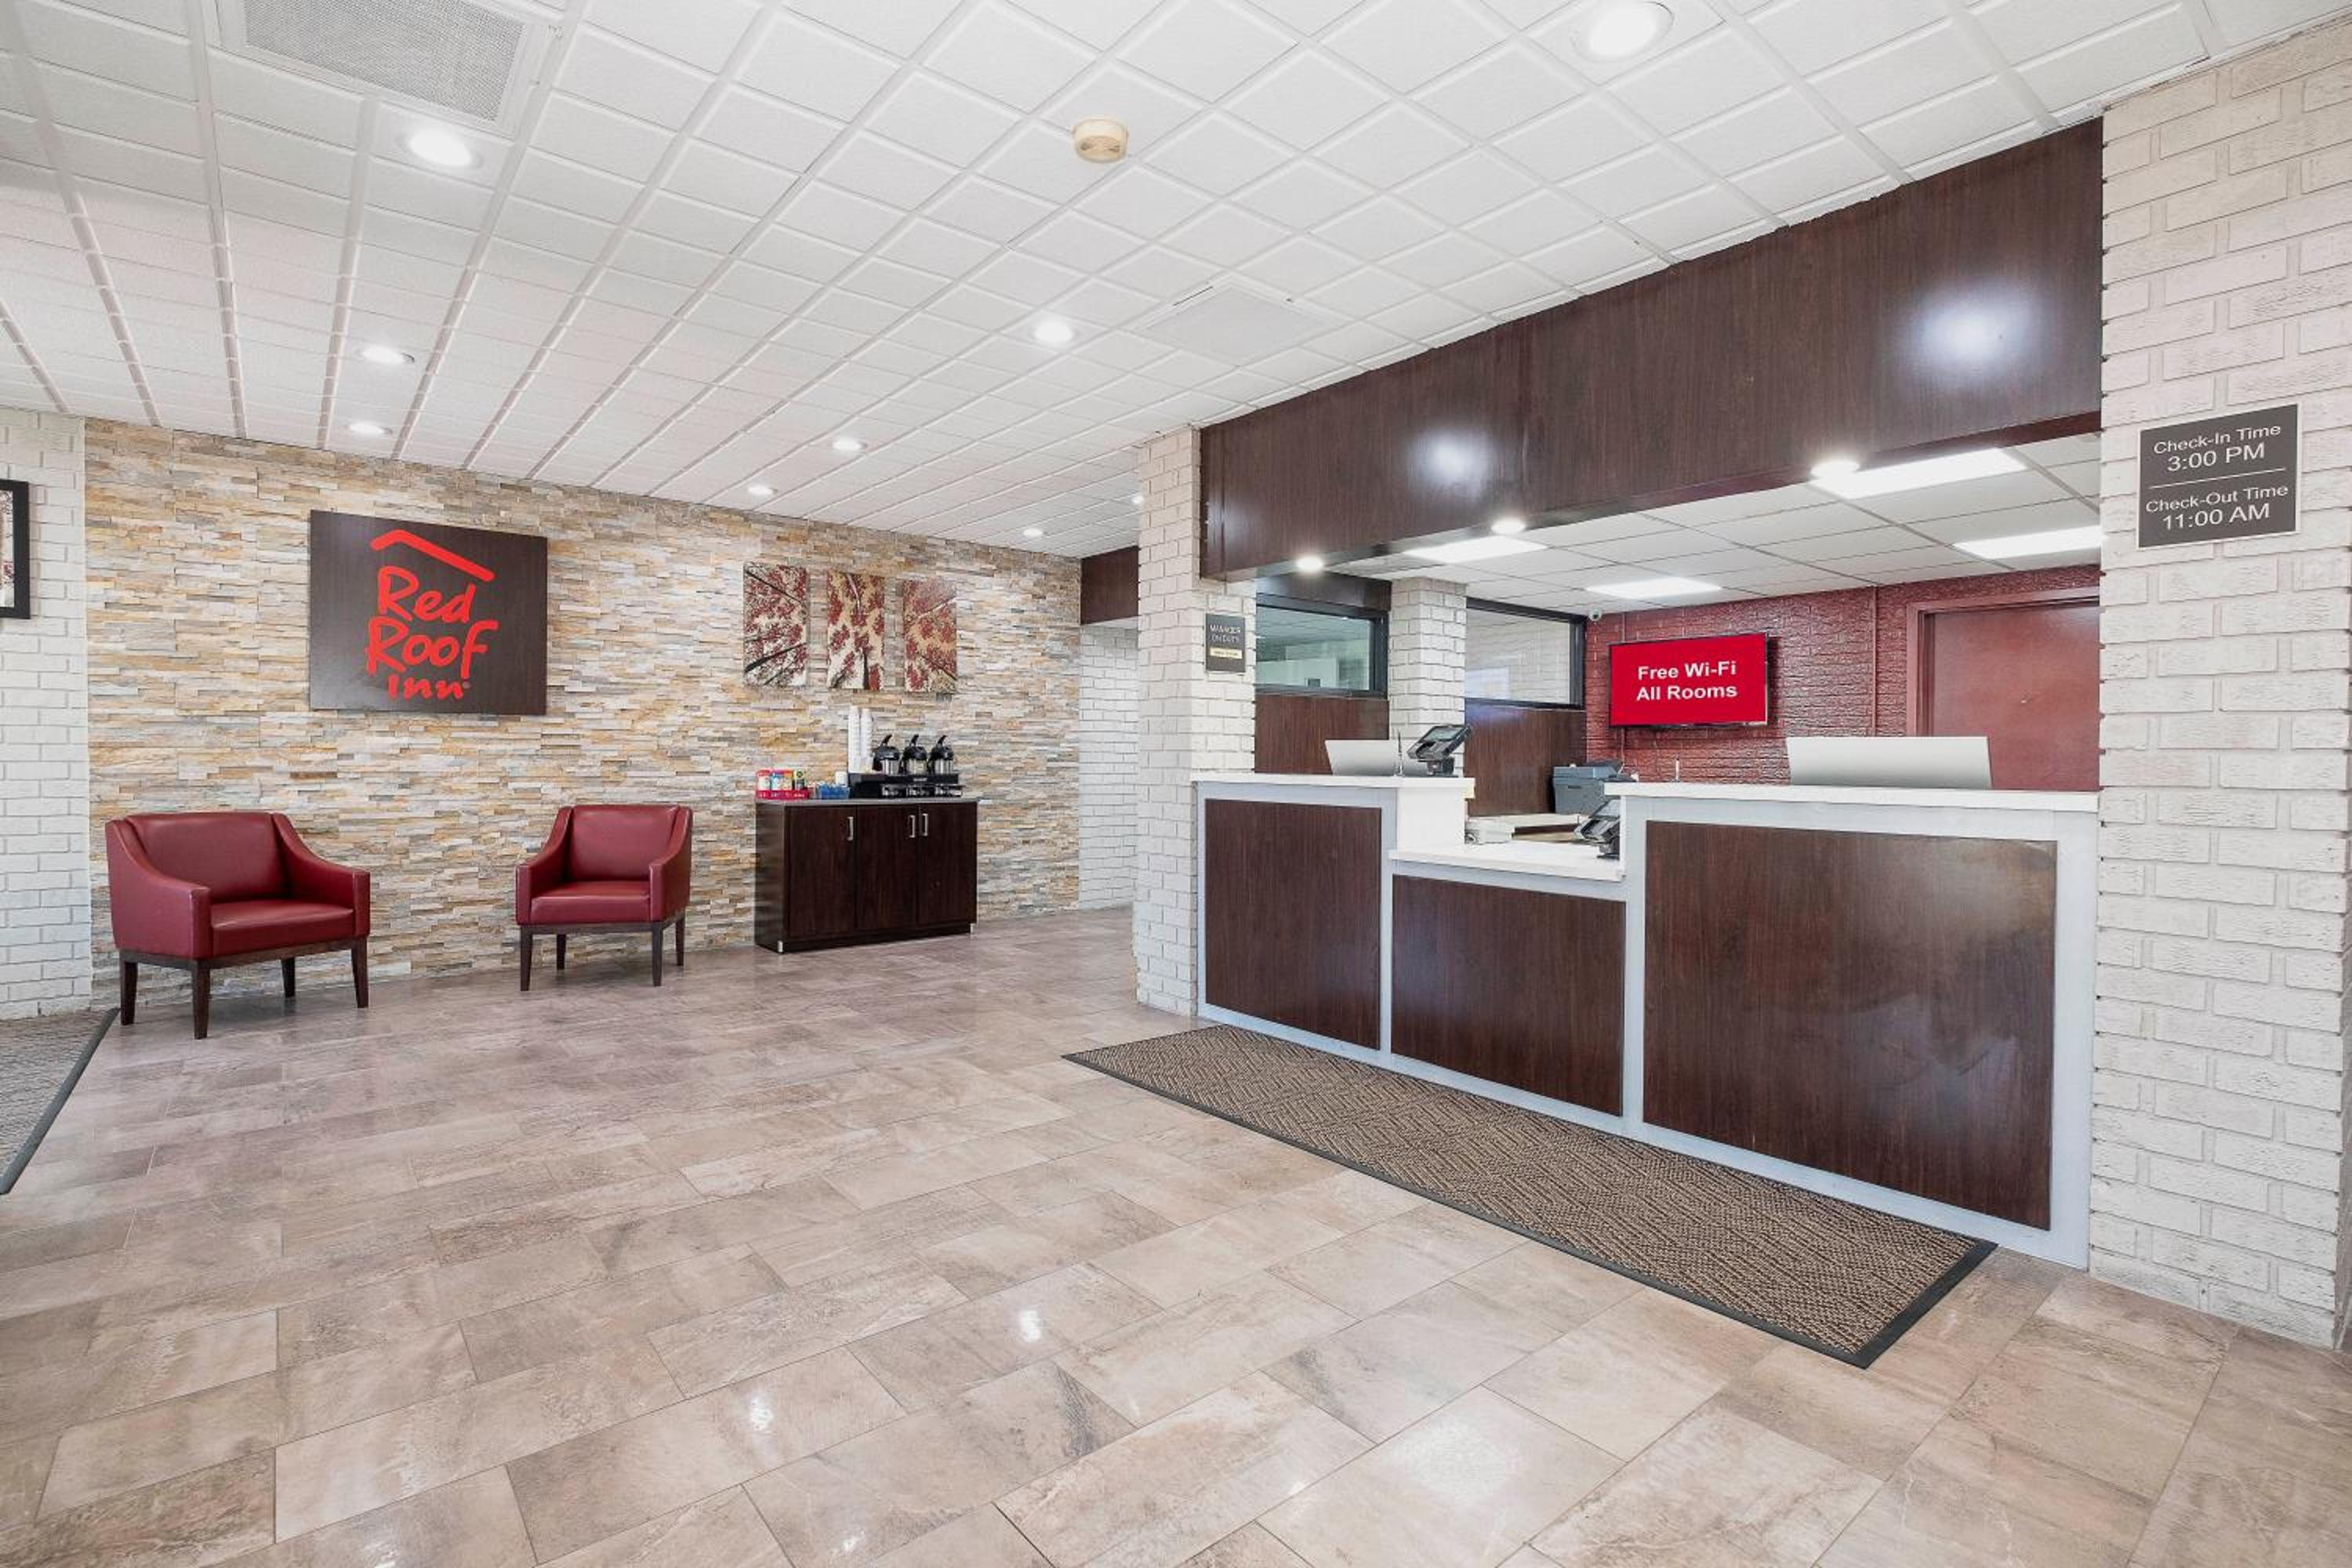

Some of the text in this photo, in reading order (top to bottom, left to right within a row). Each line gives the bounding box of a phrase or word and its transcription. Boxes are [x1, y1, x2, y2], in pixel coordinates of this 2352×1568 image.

[2154, 425, 2281, 454] Check-In Time
[2167, 442, 2265, 471] 3:00 PM
[2146, 485, 2288, 513] Check-Out Time
[2162, 503, 2270, 530] 11:00 AM
[377, 565, 476, 623] Red
[365, 615, 499, 680] Roof
[1637, 660, 1737, 681] Free Wi-Fi
[387, 674, 464, 699] Inn
[1636, 685, 1738, 701] All Rooms
